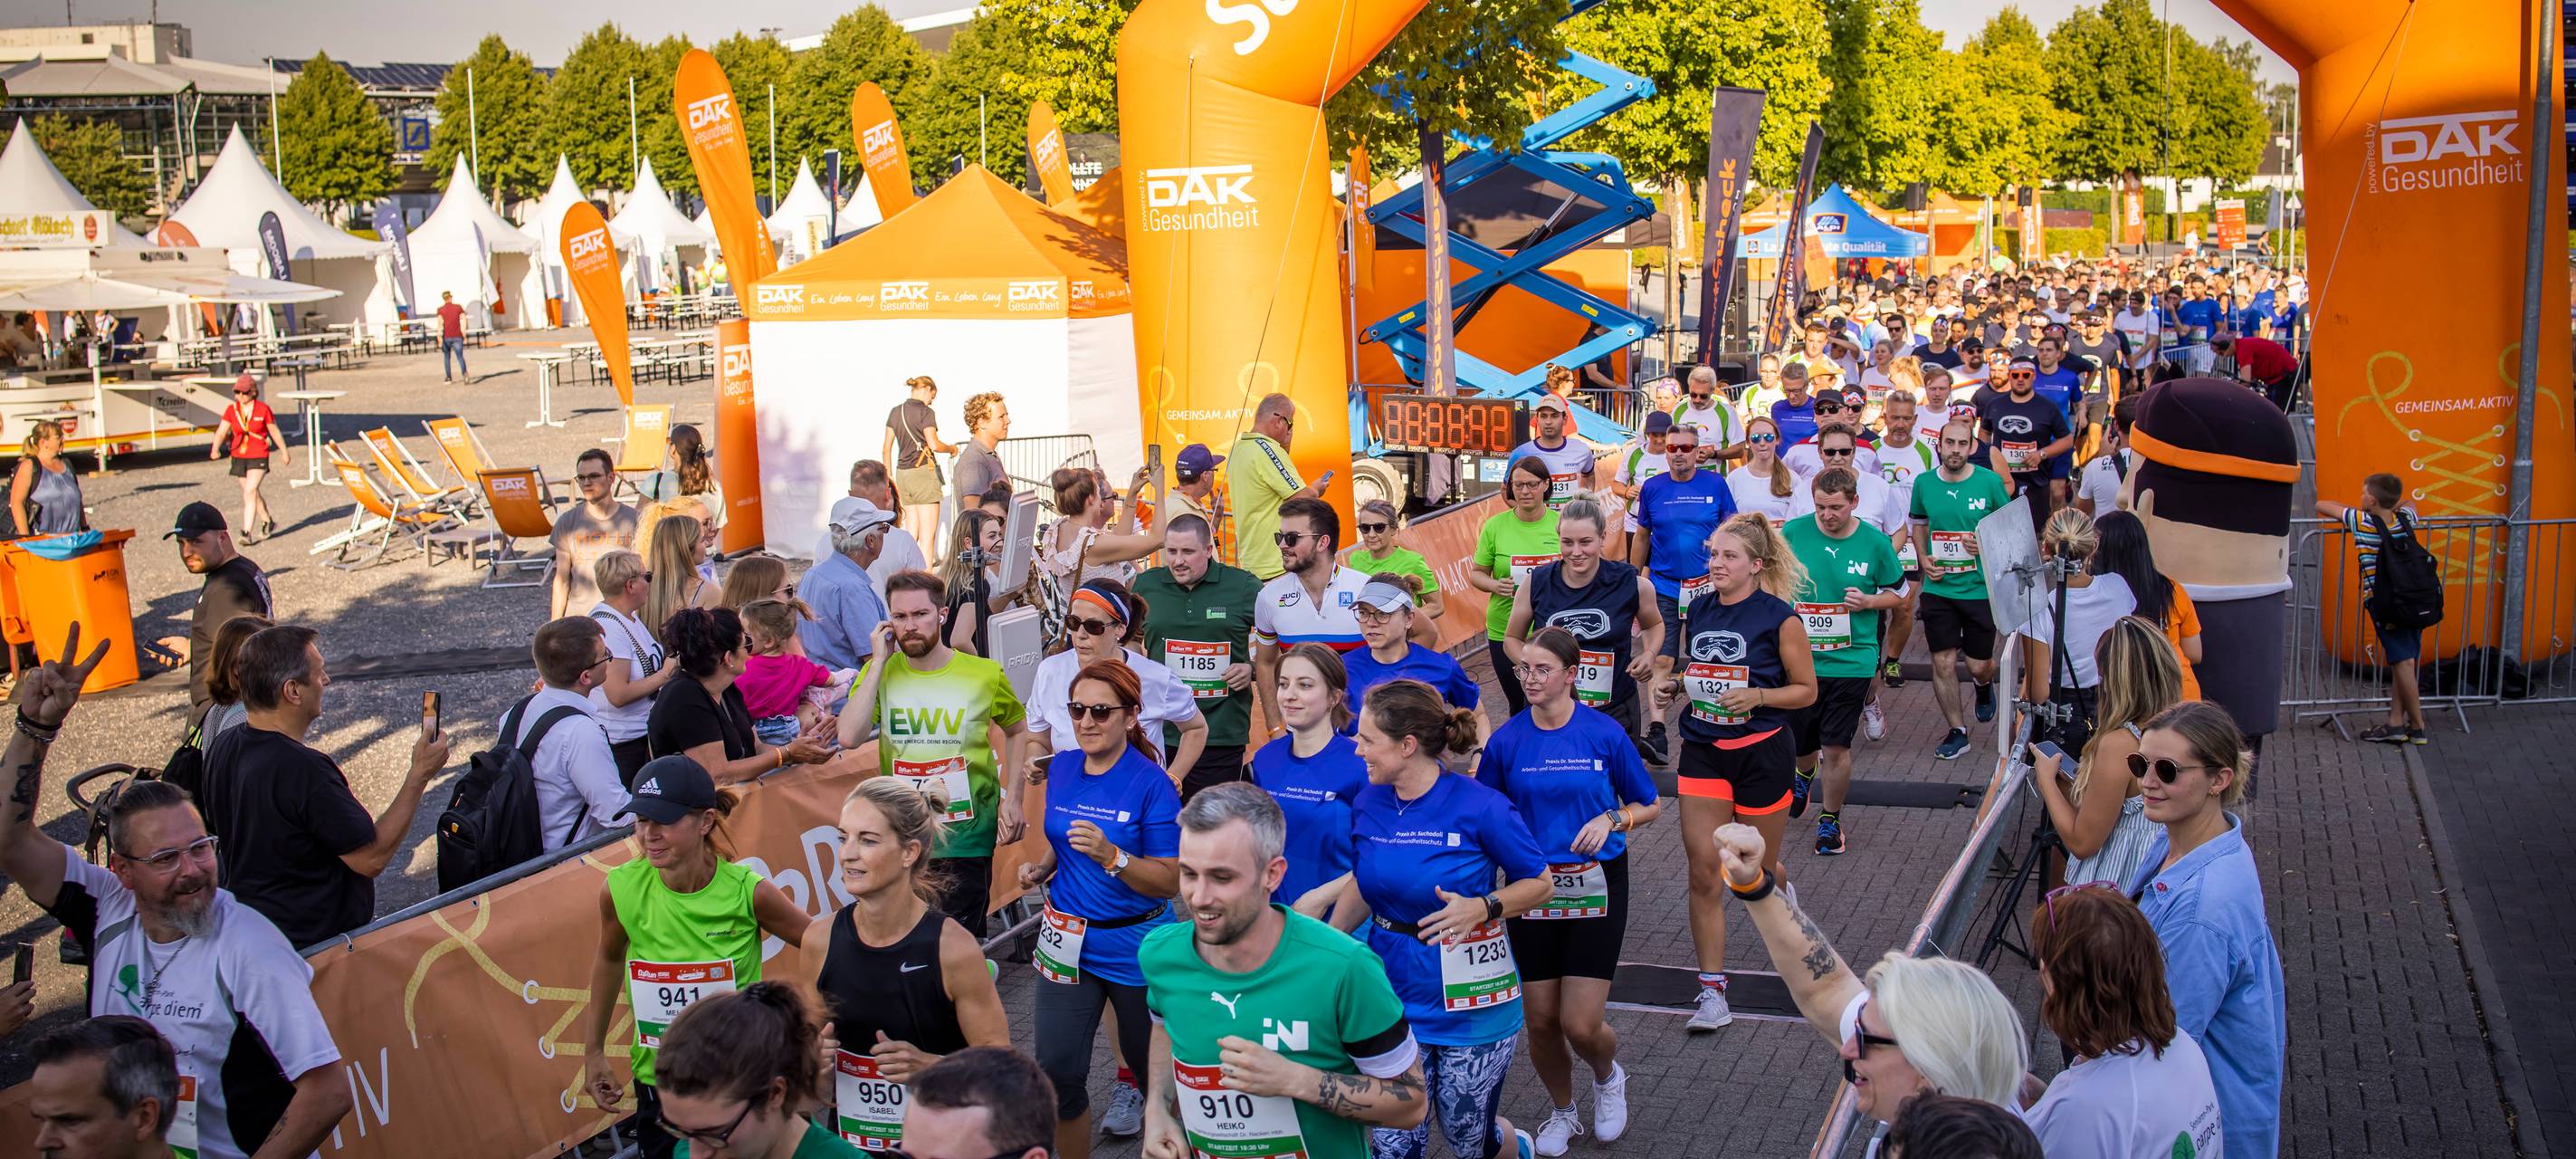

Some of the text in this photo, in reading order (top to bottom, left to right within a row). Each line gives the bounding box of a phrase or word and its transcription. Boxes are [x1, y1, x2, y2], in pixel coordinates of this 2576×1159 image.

[688, 93, 731, 129] DAK
[863, 119, 894, 153] DAK
[2380, 110, 2522, 164] DAK
[2382, 157, 2523, 193] Gesundheit
[1147, 164, 1257, 207] DAK
[1150, 204, 1259, 232] Gesundheit
[569, 227, 606, 259] DAK
[1842, 242, 1886, 253] Qualität
[757, 284, 805, 303] DAK
[880, 282, 930, 301] DAK
[1008, 281, 1059, 300] DAK
[1071, 281, 1095, 299] DAK
[758, 302, 805, 313] Gesundheit
[881, 300, 930, 311] Gesundheit
[1008, 300, 1060, 311] Gesundheit
[723, 343, 751, 378] DA
[491, 477, 527, 491] DAK
[1943, 542, 1959, 552] 901
[1809, 616, 1833, 627] 909
[1179, 656, 1216, 671] 1185
[890, 708, 966, 735] EWV
[638, 787, 662, 795] adidas
[1465, 939, 1507, 966] 1233
[658, 986, 700, 1008] 941
[858, 1081, 902, 1106] 950
[869, 1106, 897, 1115] ISABEL
[1199, 1094, 1254, 1119] 910
[1216, 1122, 1245, 1130] HEIKO
[2196, 1122, 2216, 1151] carpe
[1207, 1143, 1238, 1151] STARTZEIT
